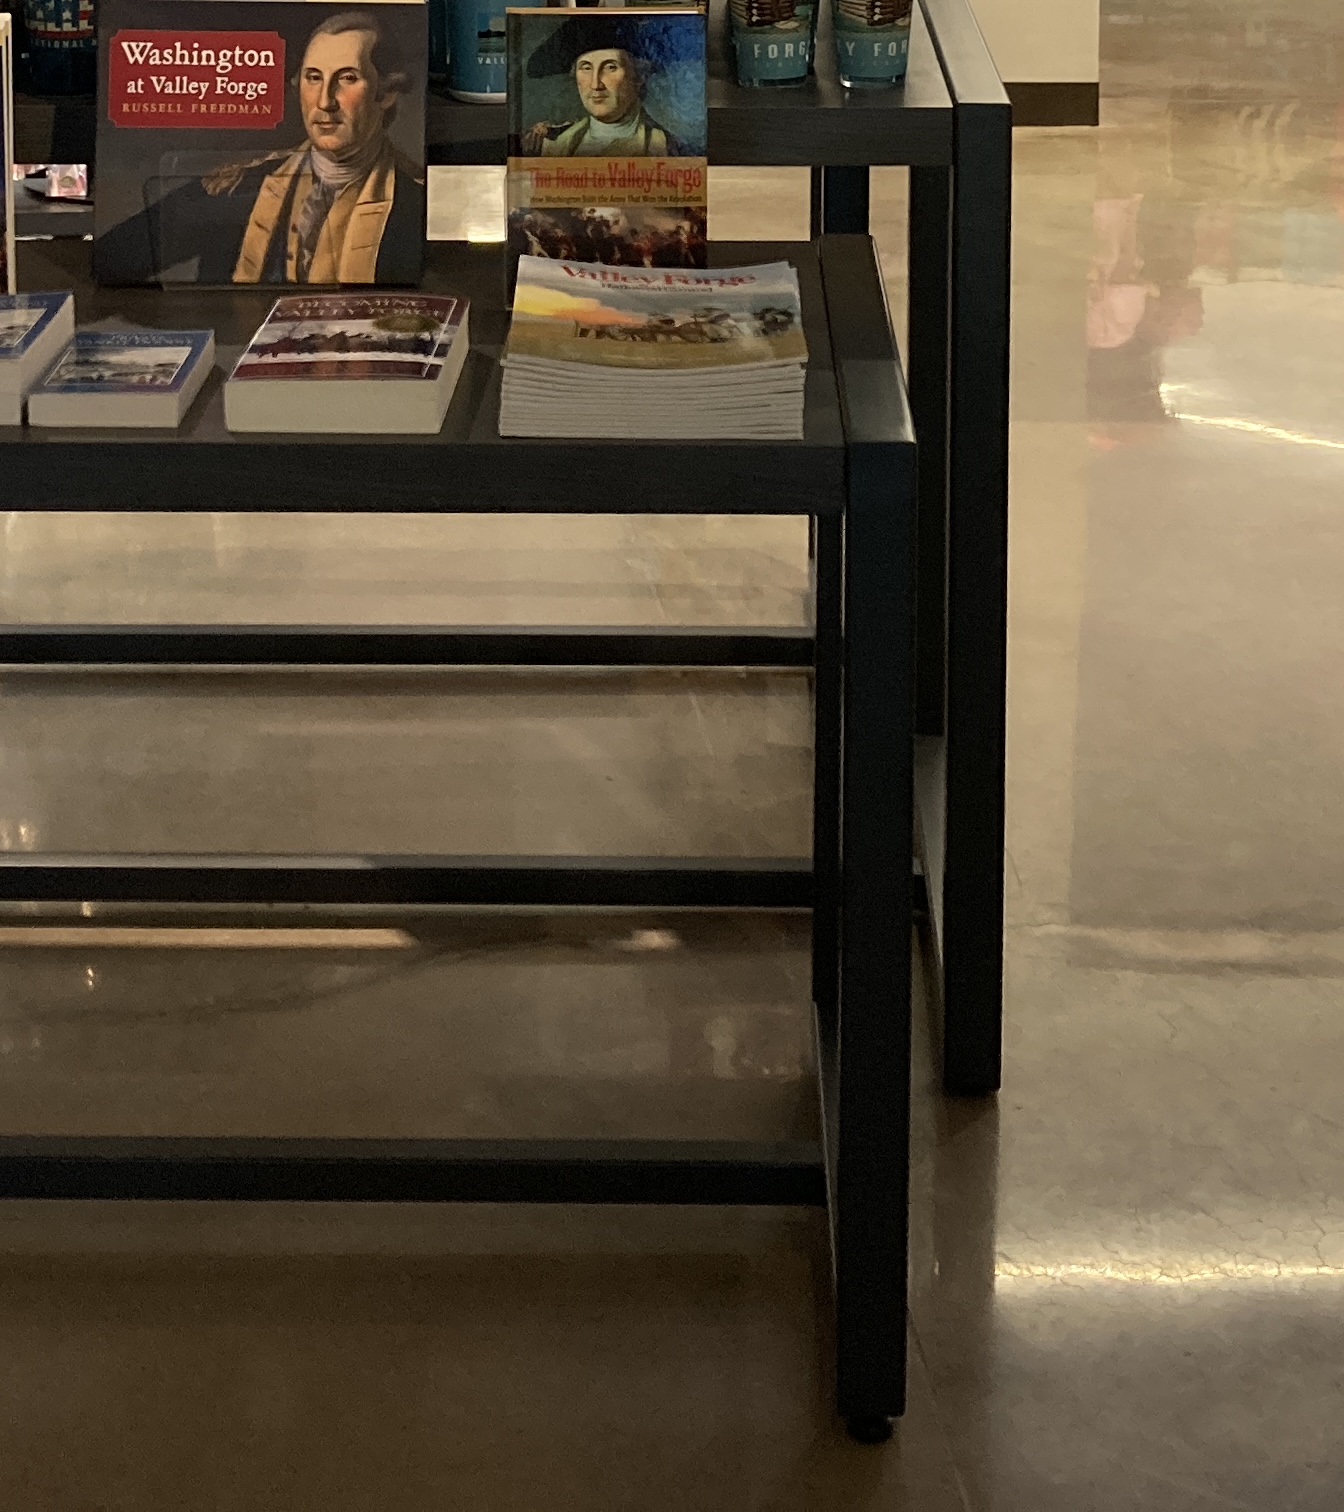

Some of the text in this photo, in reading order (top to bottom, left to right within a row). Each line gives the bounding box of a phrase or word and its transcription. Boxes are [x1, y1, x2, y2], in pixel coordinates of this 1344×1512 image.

[121, 41, 275, 73] Washington
[478, 57, 505, 65] VALL
[754, 40, 807, 59] FORG
[127, 76, 268, 100] at Valley Forge
[122, 103, 272, 114] RUSSELL FREEDMAN
[529, 162, 702, 194] The Road to Valley Forge
[562, 264, 756, 287] Valley Forge
